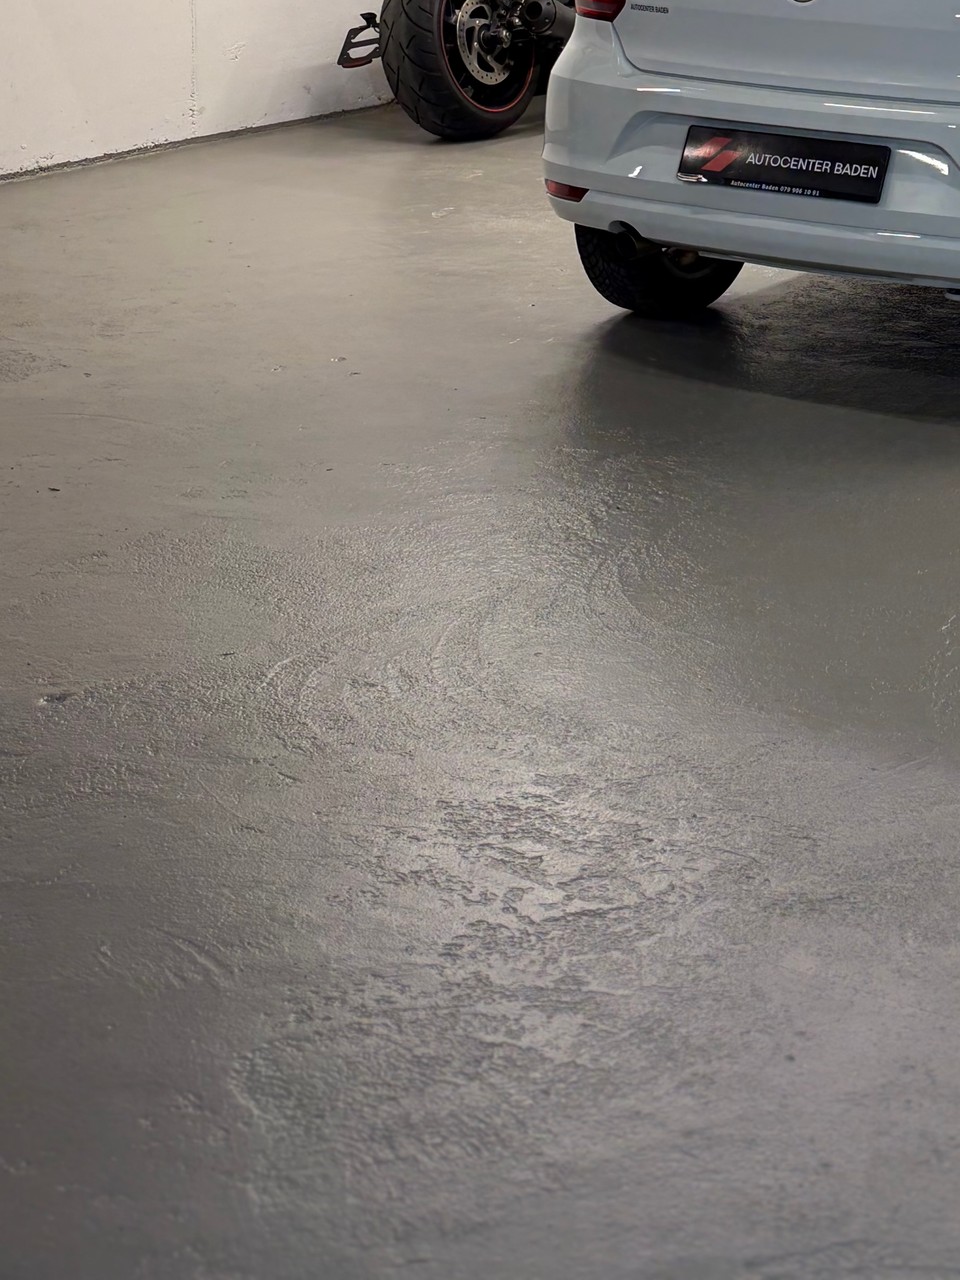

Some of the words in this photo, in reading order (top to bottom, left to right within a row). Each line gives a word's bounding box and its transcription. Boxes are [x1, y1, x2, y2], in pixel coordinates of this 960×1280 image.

[745, 152, 832, 173] AUTOCENTER
[833, 162, 879, 179] BADEN
[730, 179, 761, 189] Autocenter
